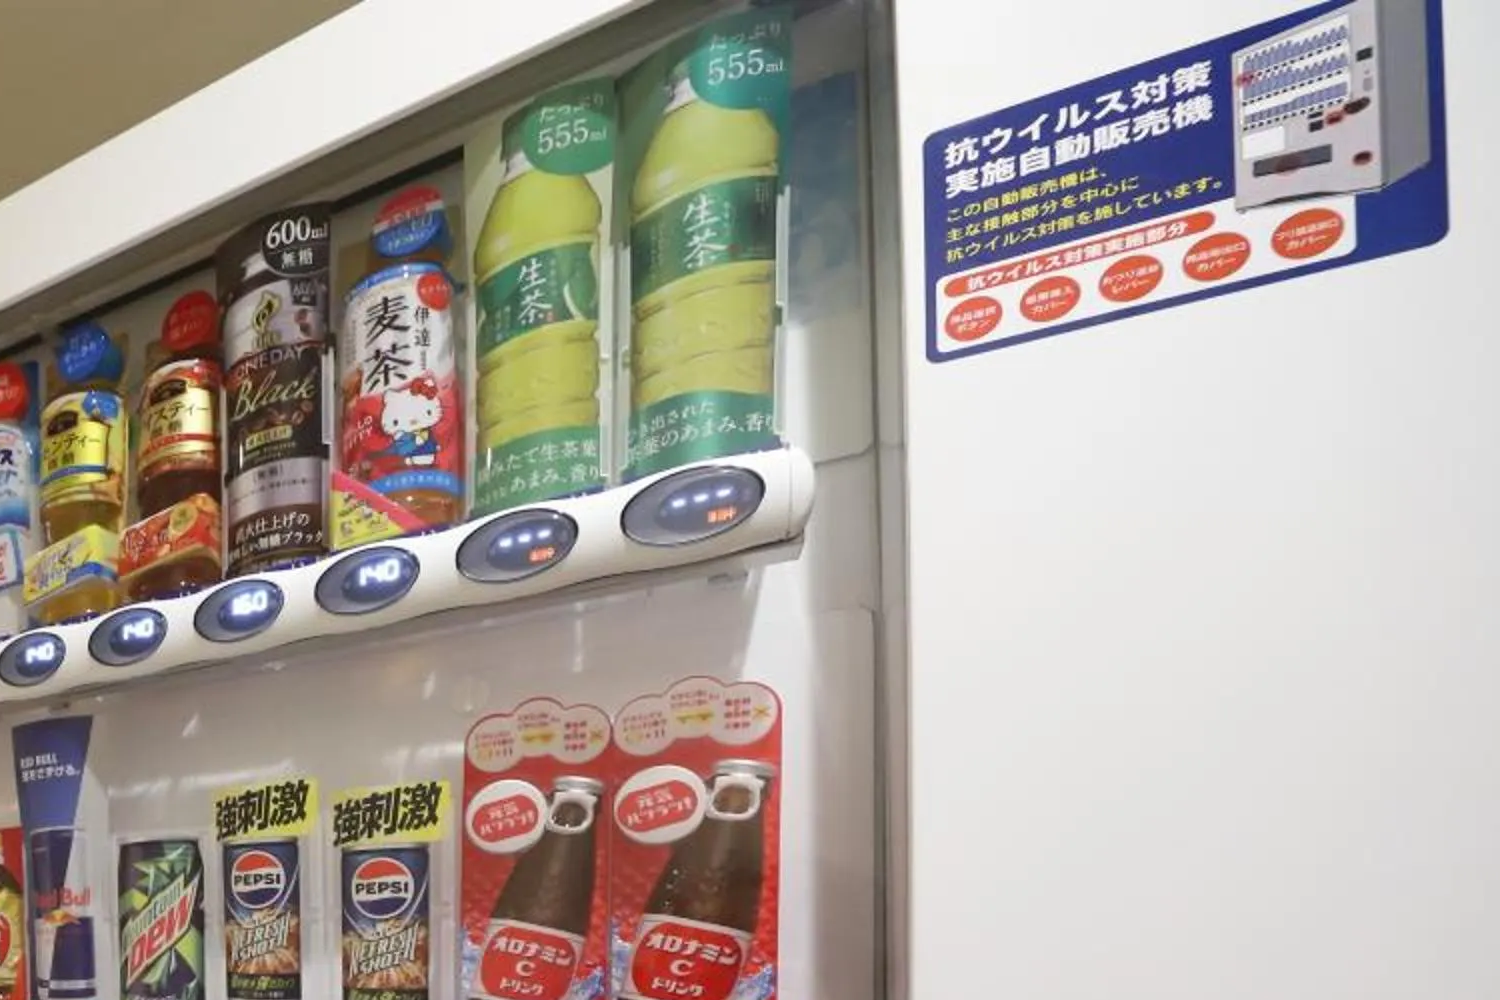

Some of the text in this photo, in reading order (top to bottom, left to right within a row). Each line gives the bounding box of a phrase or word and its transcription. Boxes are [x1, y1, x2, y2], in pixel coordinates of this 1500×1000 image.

[945, 60, 1213, 168] 抗ウイルス対策
[945, 94, 1213, 197] 実施自動販売機
[683, 193, 727, 269] 生茶
[966, 219, 1188, 292] 抗ウイルス対策実施部分
[516, 257, 554, 326] 生茶
[363, 294, 412, 393] 麦茶
[231, 366, 316, 423] Black
[215, 778, 311, 842] 強刺激
[332, 780, 443, 848] 強刺激
[233, 872, 281, 886] PEPSI
[354, 880, 409, 896] PEPSI
[493, 935, 573, 966] オロナミン
[645, 932, 738, 966] オロナミン
[499, 977, 545, 997] ドリンク
[651, 977, 706, 998] ドリンク
